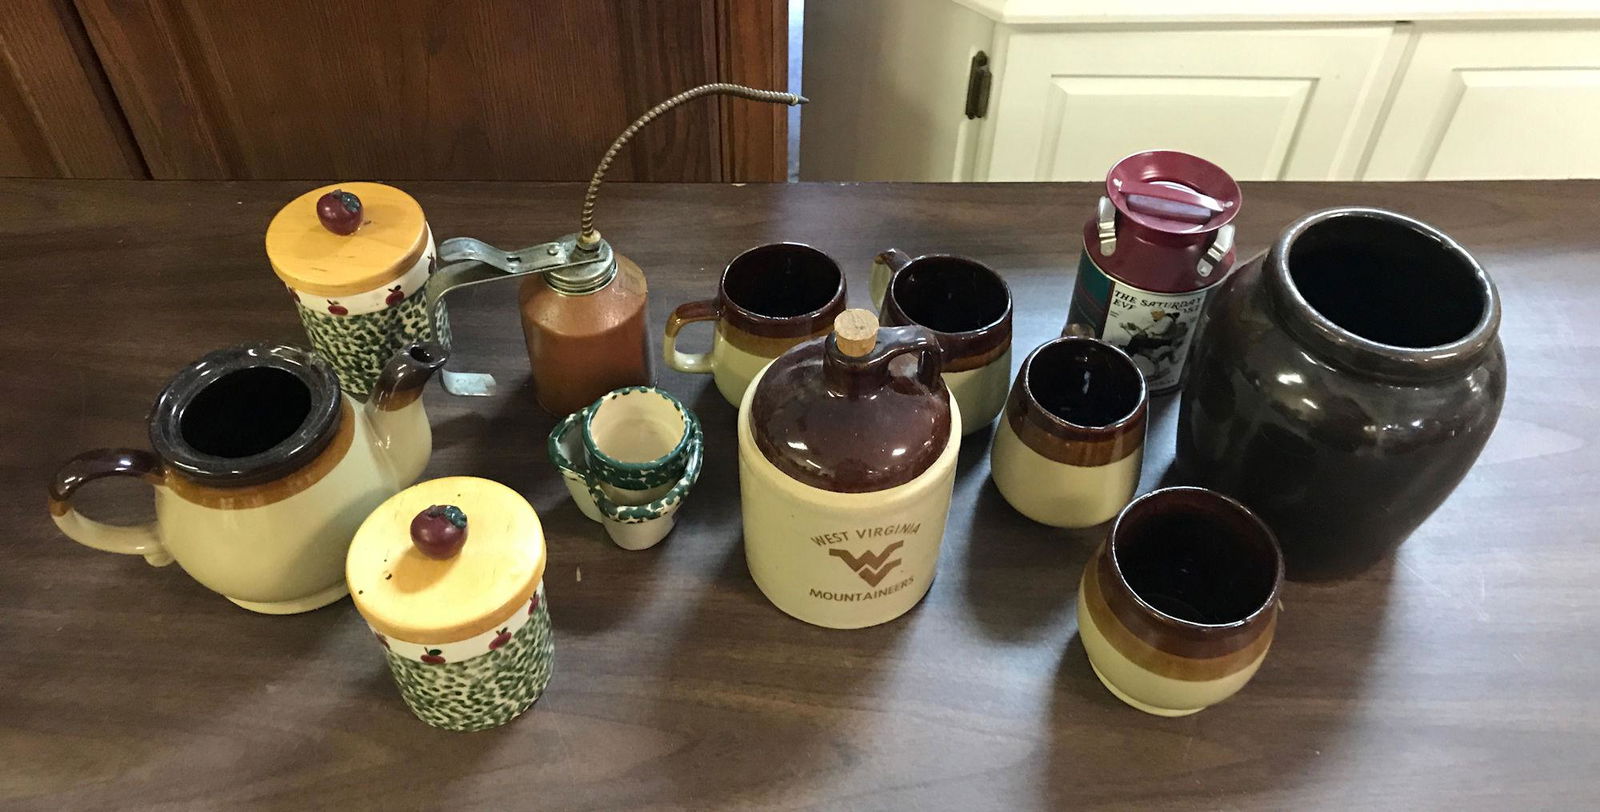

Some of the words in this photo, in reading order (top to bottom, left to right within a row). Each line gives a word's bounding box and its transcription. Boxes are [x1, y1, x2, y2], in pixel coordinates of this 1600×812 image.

[1114, 290, 1137, 304] THE
[1140, 297, 1201, 309] SATURDAY
[810, 531, 849, 547] WEST
[855, 523, 921, 539] VIRGINIA
[809, 576, 914, 602] MOUNTAINEERS
